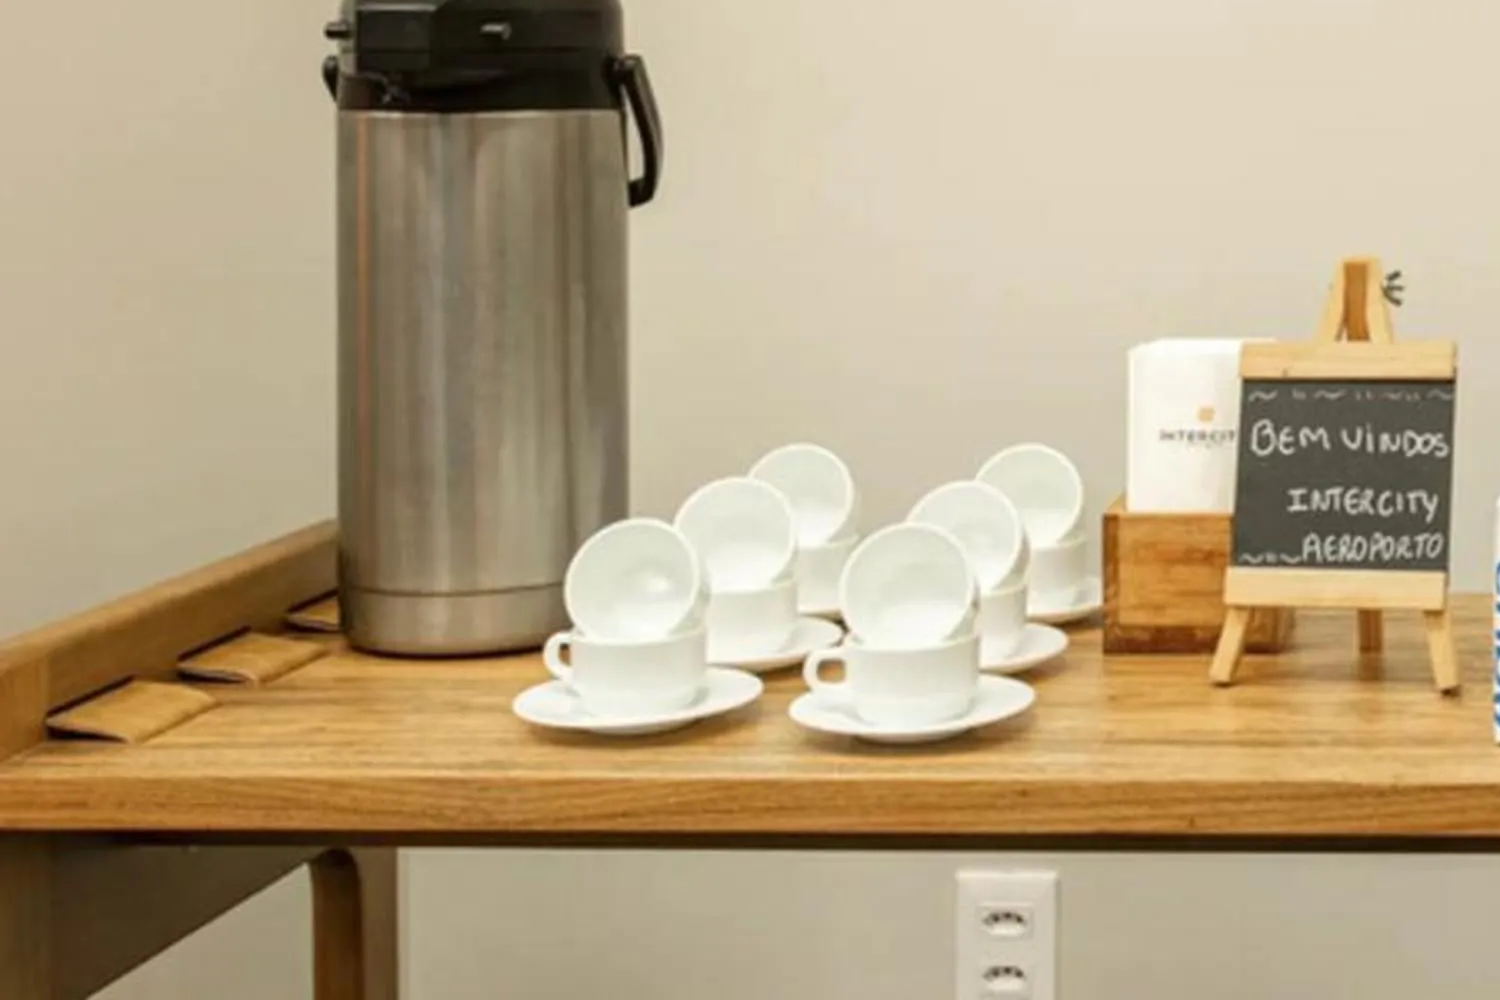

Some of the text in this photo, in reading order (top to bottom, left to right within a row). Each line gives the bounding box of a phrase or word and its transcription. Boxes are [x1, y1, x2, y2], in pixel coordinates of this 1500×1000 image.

[1158, 427, 1236, 442] INTERCIT
[1251, 417, 1332, 457] BEM
[1286, 486, 1440, 524] INTERCITY
[1302, 531, 1445, 563] AEROPORTO
